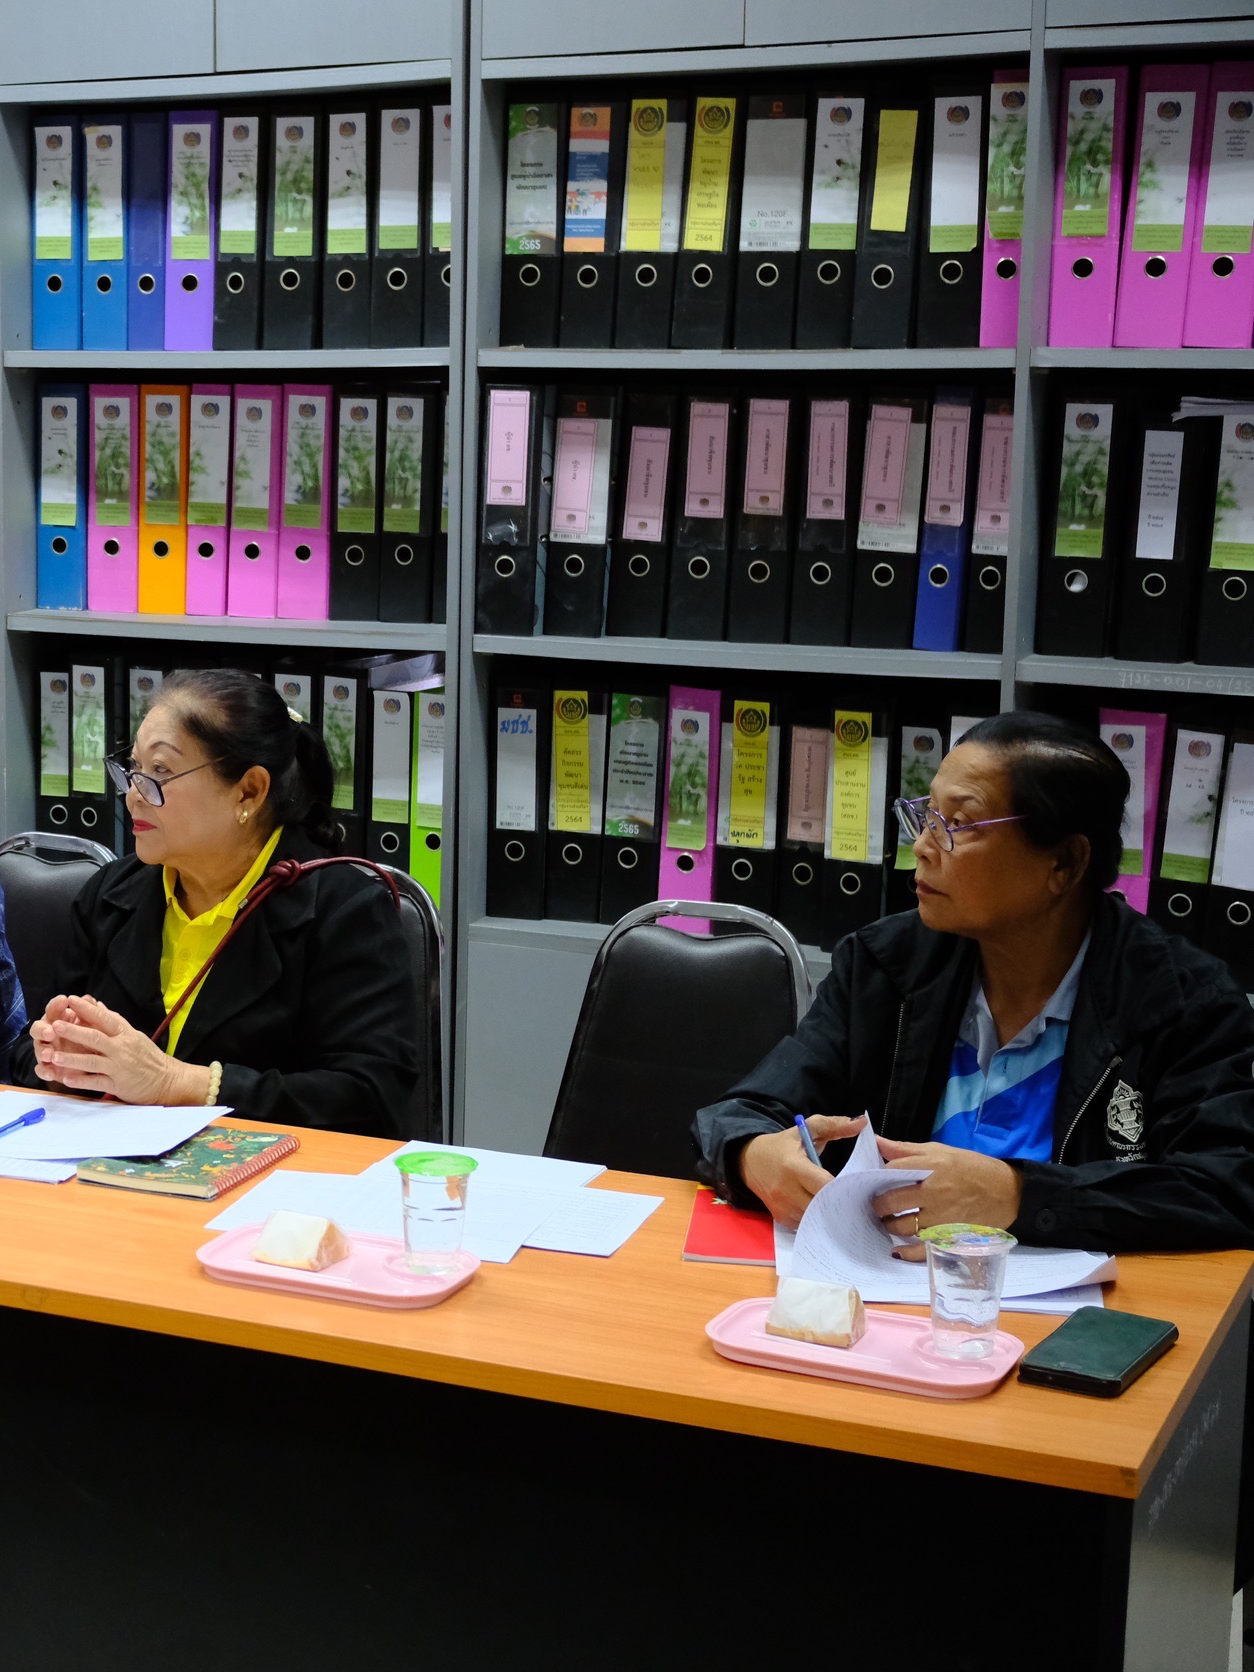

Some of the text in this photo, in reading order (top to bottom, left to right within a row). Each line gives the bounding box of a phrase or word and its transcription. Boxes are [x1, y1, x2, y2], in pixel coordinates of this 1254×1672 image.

[694, 233, 713, 242] 2564
[519, 239, 541, 250] 2565
[737, 748, 763, 759] โครงการ
[564, 815, 583, 823] 2564
[617, 823, 640, 836] 2565
[839, 843, 858, 853] 2564
